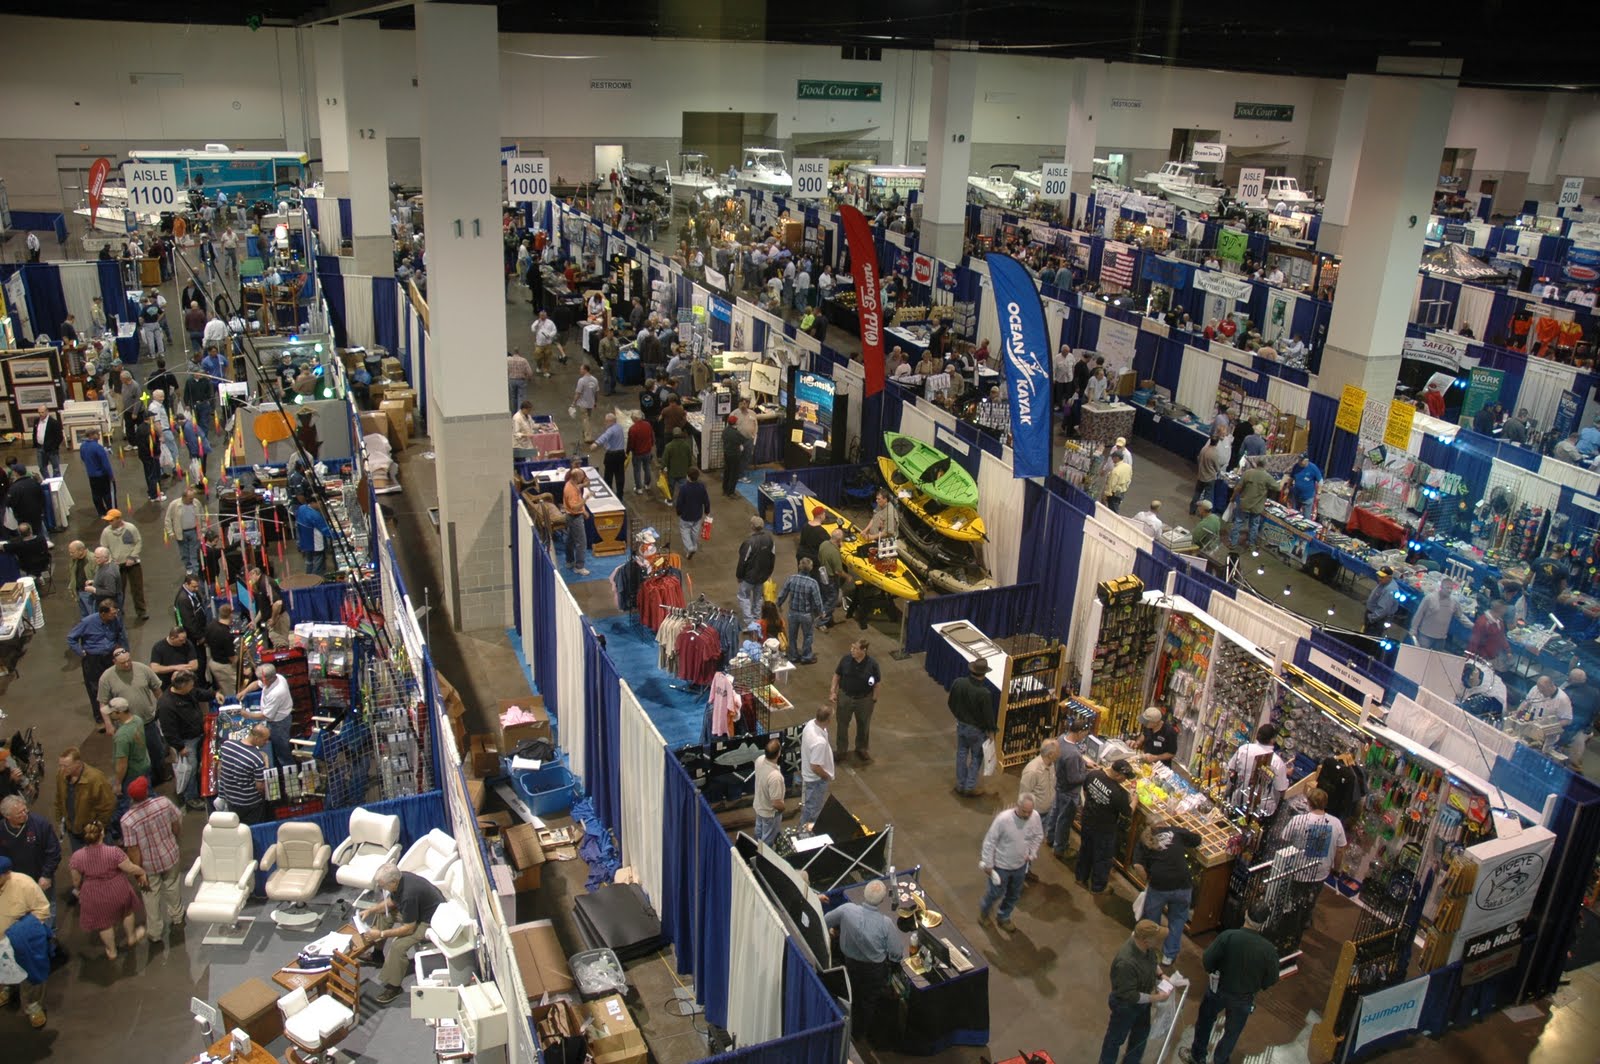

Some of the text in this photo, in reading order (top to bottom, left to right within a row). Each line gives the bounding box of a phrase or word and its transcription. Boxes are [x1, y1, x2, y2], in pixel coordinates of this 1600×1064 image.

[590, 81, 632, 90] RESTROOMS
[799, 84, 858, 97] Food Court
[325, 98, 338, 106] 13
[1112, 100, 1142, 109] RESTROOMS
[1236, 106, 1278, 117] Food Court
[358, 128, 376, 140] 12
[951, 133, 966, 144] 10
[514, 163, 543, 174] AISLE
[798, 163, 823, 173] AISLE
[1046, 167, 1068, 177] AISLE
[133, 169, 168, 181] AISLE
[1243, 172, 1261, 182] AISLE
[510, 178, 548, 195] 1000
[797, 177, 823, 192] 900
[1045, 180, 1066, 195] 800
[1242, 184, 1259, 197] 700
[1564, 181, 1582, 189] AISLE
[130, 186, 174, 205] 1100
[1561, 191, 1578, 204] 500
[453, 218, 481, 239] 11
[1408, 215, 1418, 229] 9
[860, 262, 878, 347] Old Town
[1422, 341, 1457, 356] SAFE/SEA
[1007, 301, 1032, 426] OCEAN KAYAK
[1472, 374, 1500, 385] WORK
[1092, 777, 1112, 797] USMC
[1495, 855, 1534, 878] BIGEYE
[1466, 928, 1521, 957] Fish Hard.
[1361, 999, 1416, 1025] SHIMANO
